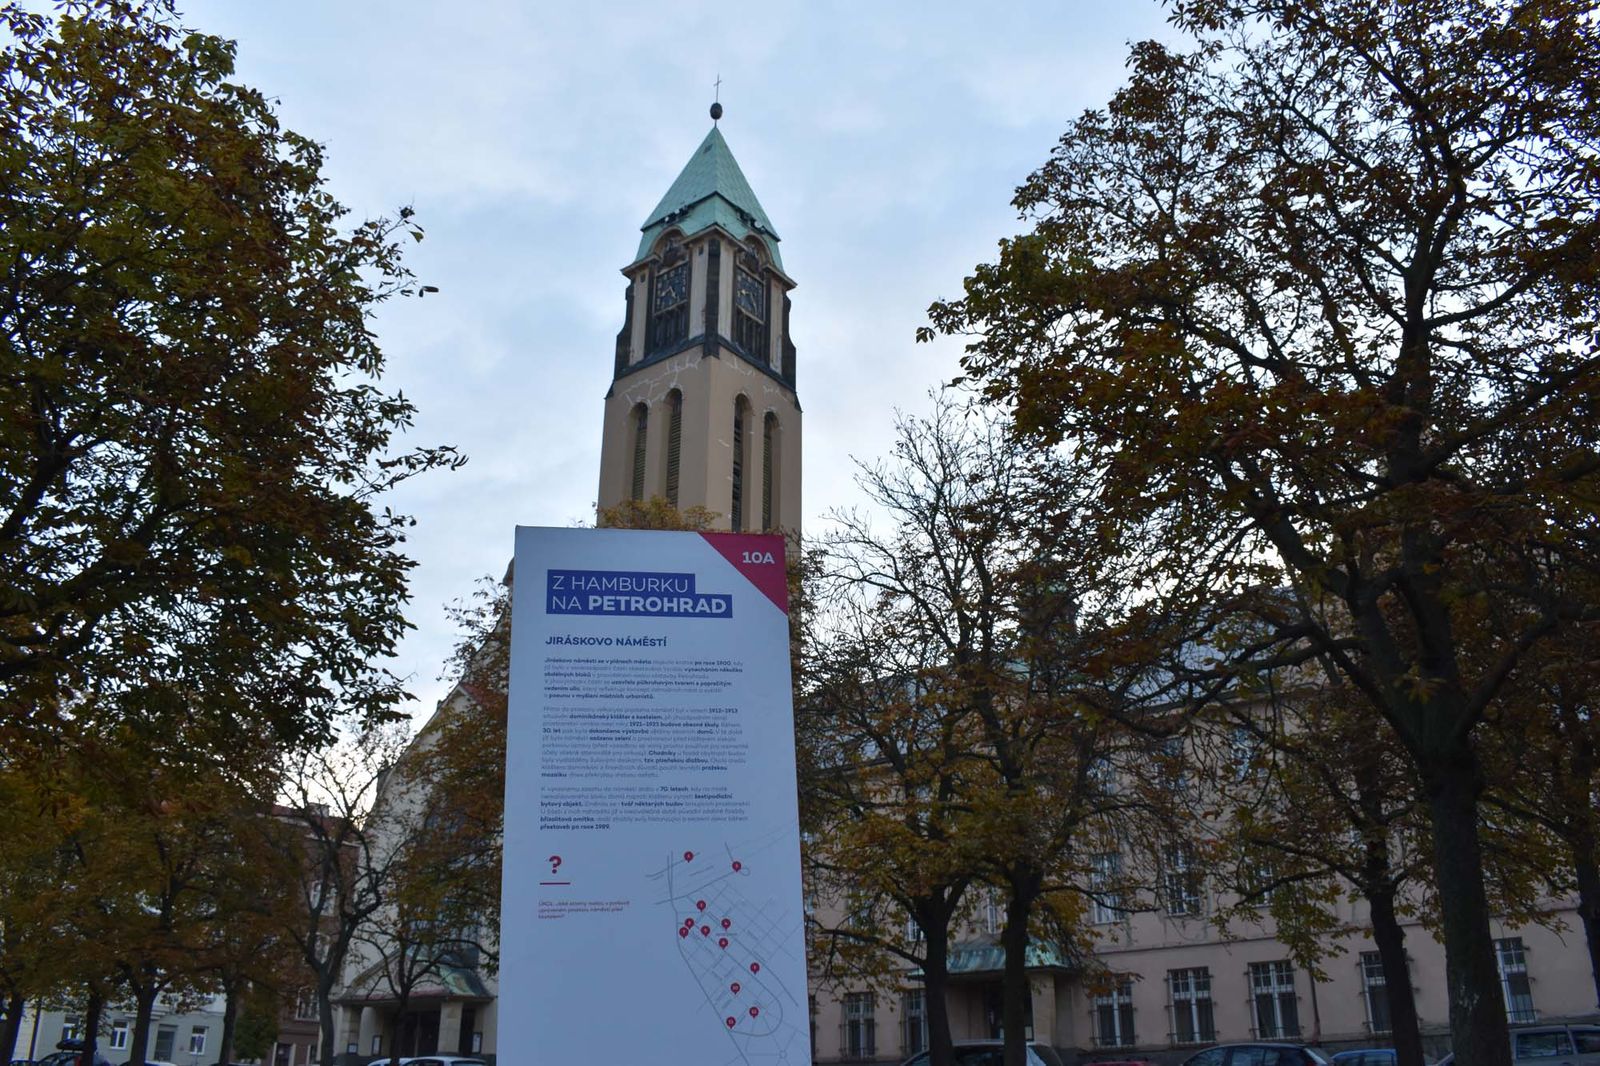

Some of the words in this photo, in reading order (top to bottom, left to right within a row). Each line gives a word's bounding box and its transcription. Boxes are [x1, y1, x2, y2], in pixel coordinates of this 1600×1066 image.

[742, 552, 775, 565] 10A
[552, 576, 564, 590] Z
[571, 576, 688, 593] HAMBURKU
[552, 596, 582, 610] NA
[589, 597, 726, 614] PETROHRAD
[545, 635, 612, 646] JIRÁSKOVO
[616, 636, 667, 647] NÁMĚSTÍ
[548, 855, 562, 874] ?
